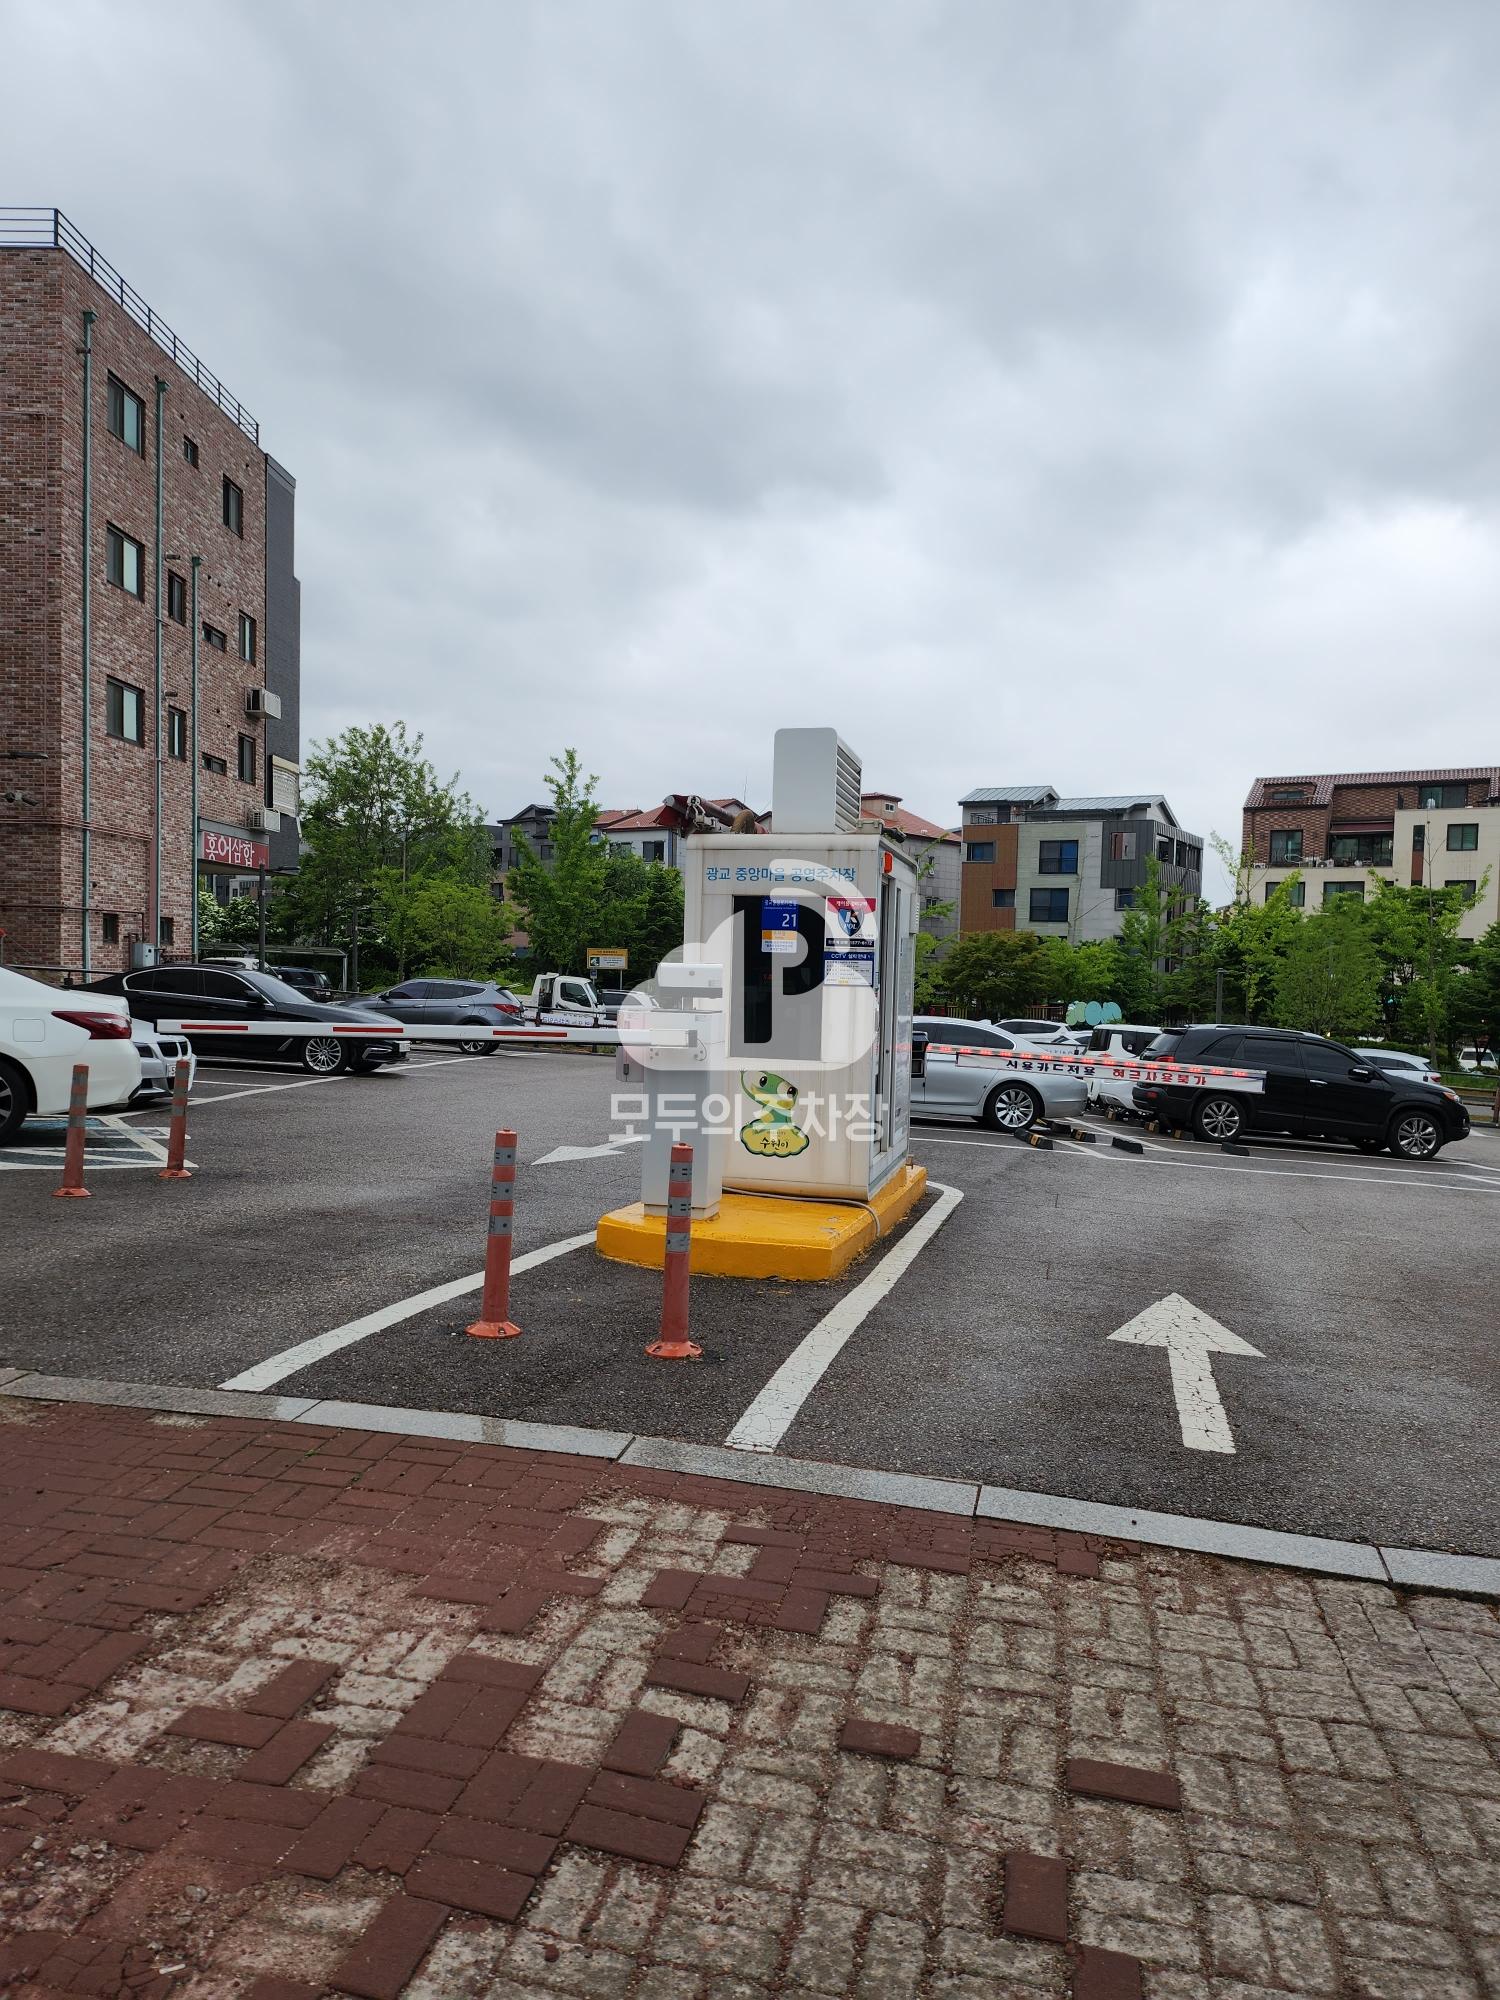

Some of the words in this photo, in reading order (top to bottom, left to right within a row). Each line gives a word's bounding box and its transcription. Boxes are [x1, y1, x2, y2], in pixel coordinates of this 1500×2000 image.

[205, 834, 255, 868] 홍어삼합
[706, 867, 731, 881] 광교
[736, 867, 785, 881] 중앙마을
[791, 867, 856, 882] 공영주차장
[782, 913, 797, 927] 21
[760, 1137, 789, 1151] 수원이
